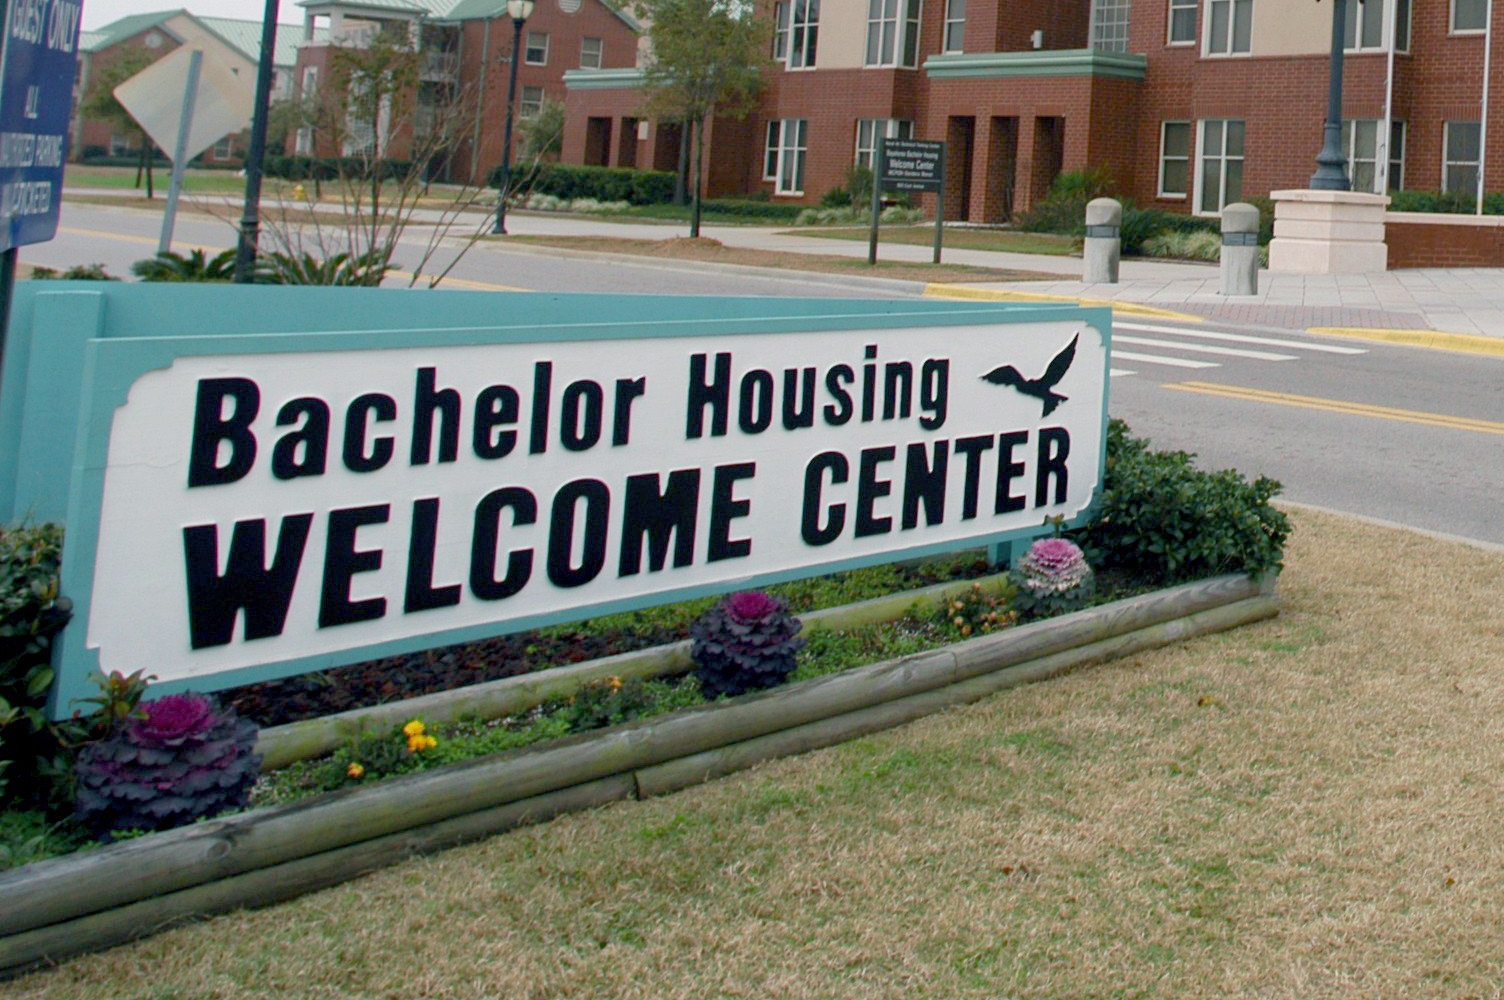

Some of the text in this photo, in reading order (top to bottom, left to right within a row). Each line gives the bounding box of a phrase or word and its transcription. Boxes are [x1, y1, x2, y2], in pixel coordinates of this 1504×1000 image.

[187, 345, 950, 489] Bachelor Housing
[182, 426, 1071, 651] WELCOME CENTER
